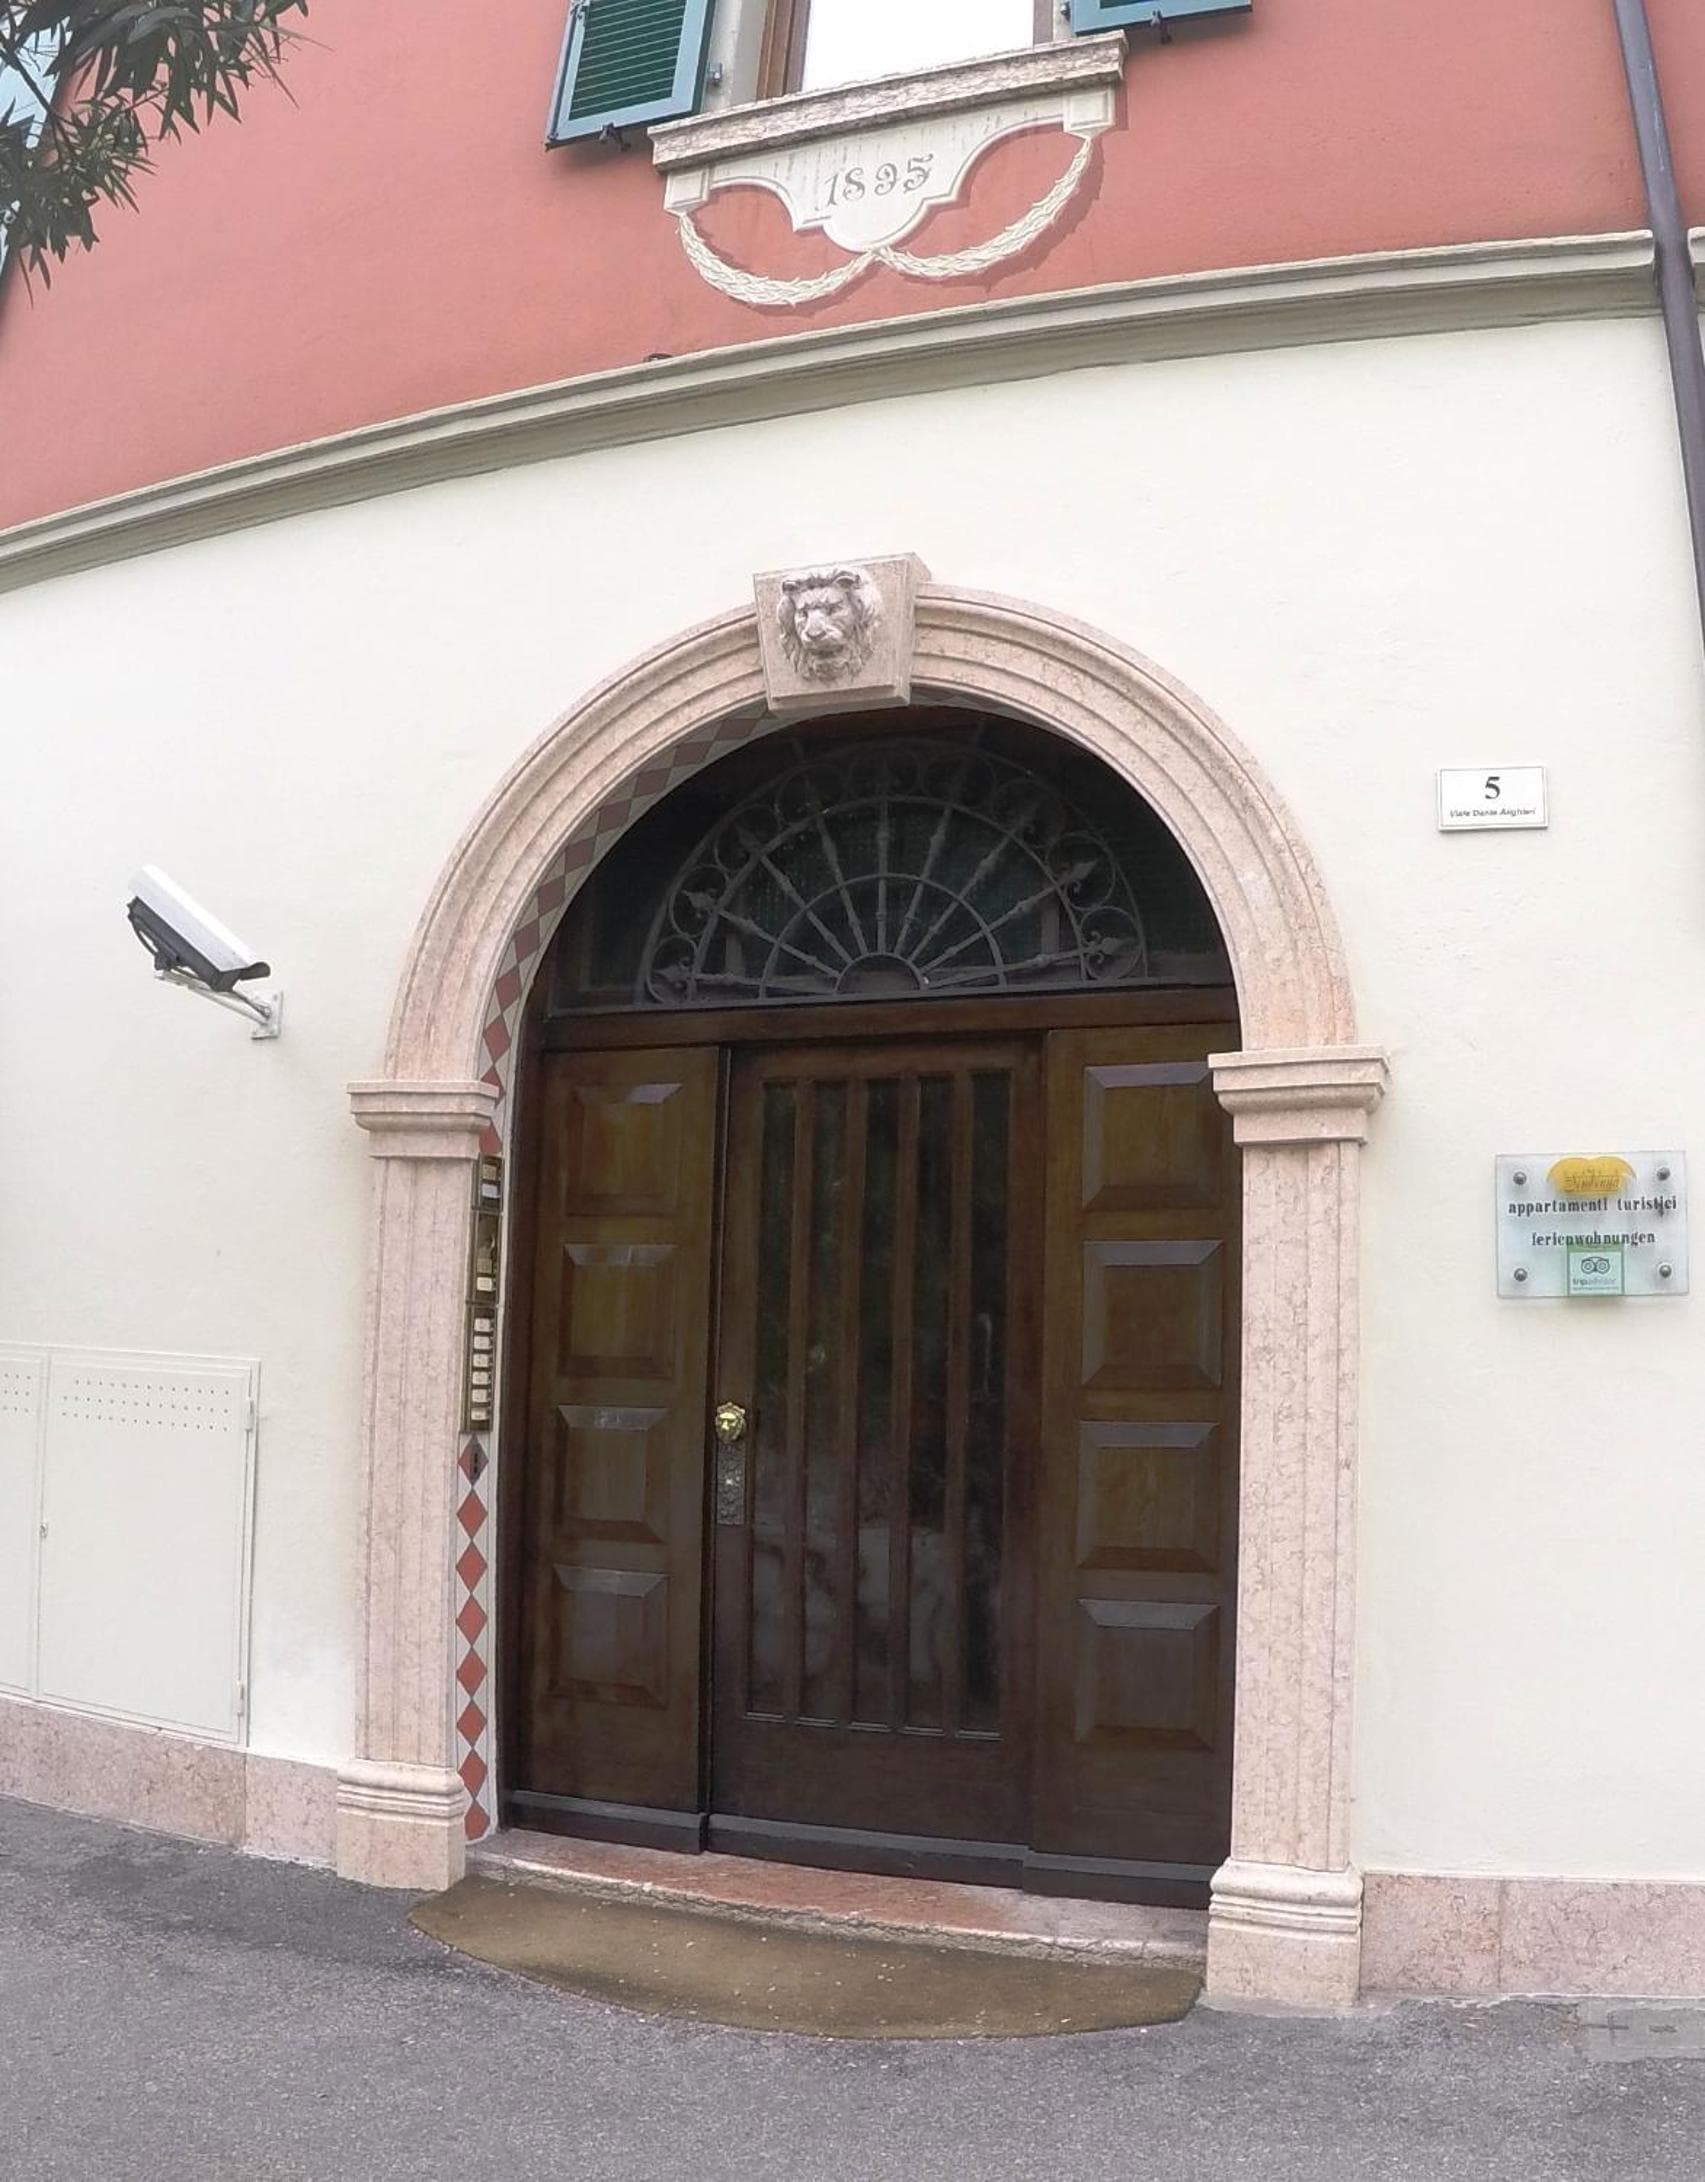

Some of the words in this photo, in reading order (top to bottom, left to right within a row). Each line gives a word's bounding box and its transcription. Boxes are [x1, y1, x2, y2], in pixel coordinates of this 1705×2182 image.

[824, 153, 934, 207] 1895
[1484, 776, 1501, 800] 5
[1508, 1198, 1608, 1217] appartamenti
[1617, 1195, 1677, 1212] turistici
[1531, 1230, 1656, 1247] ferienwohnungen
